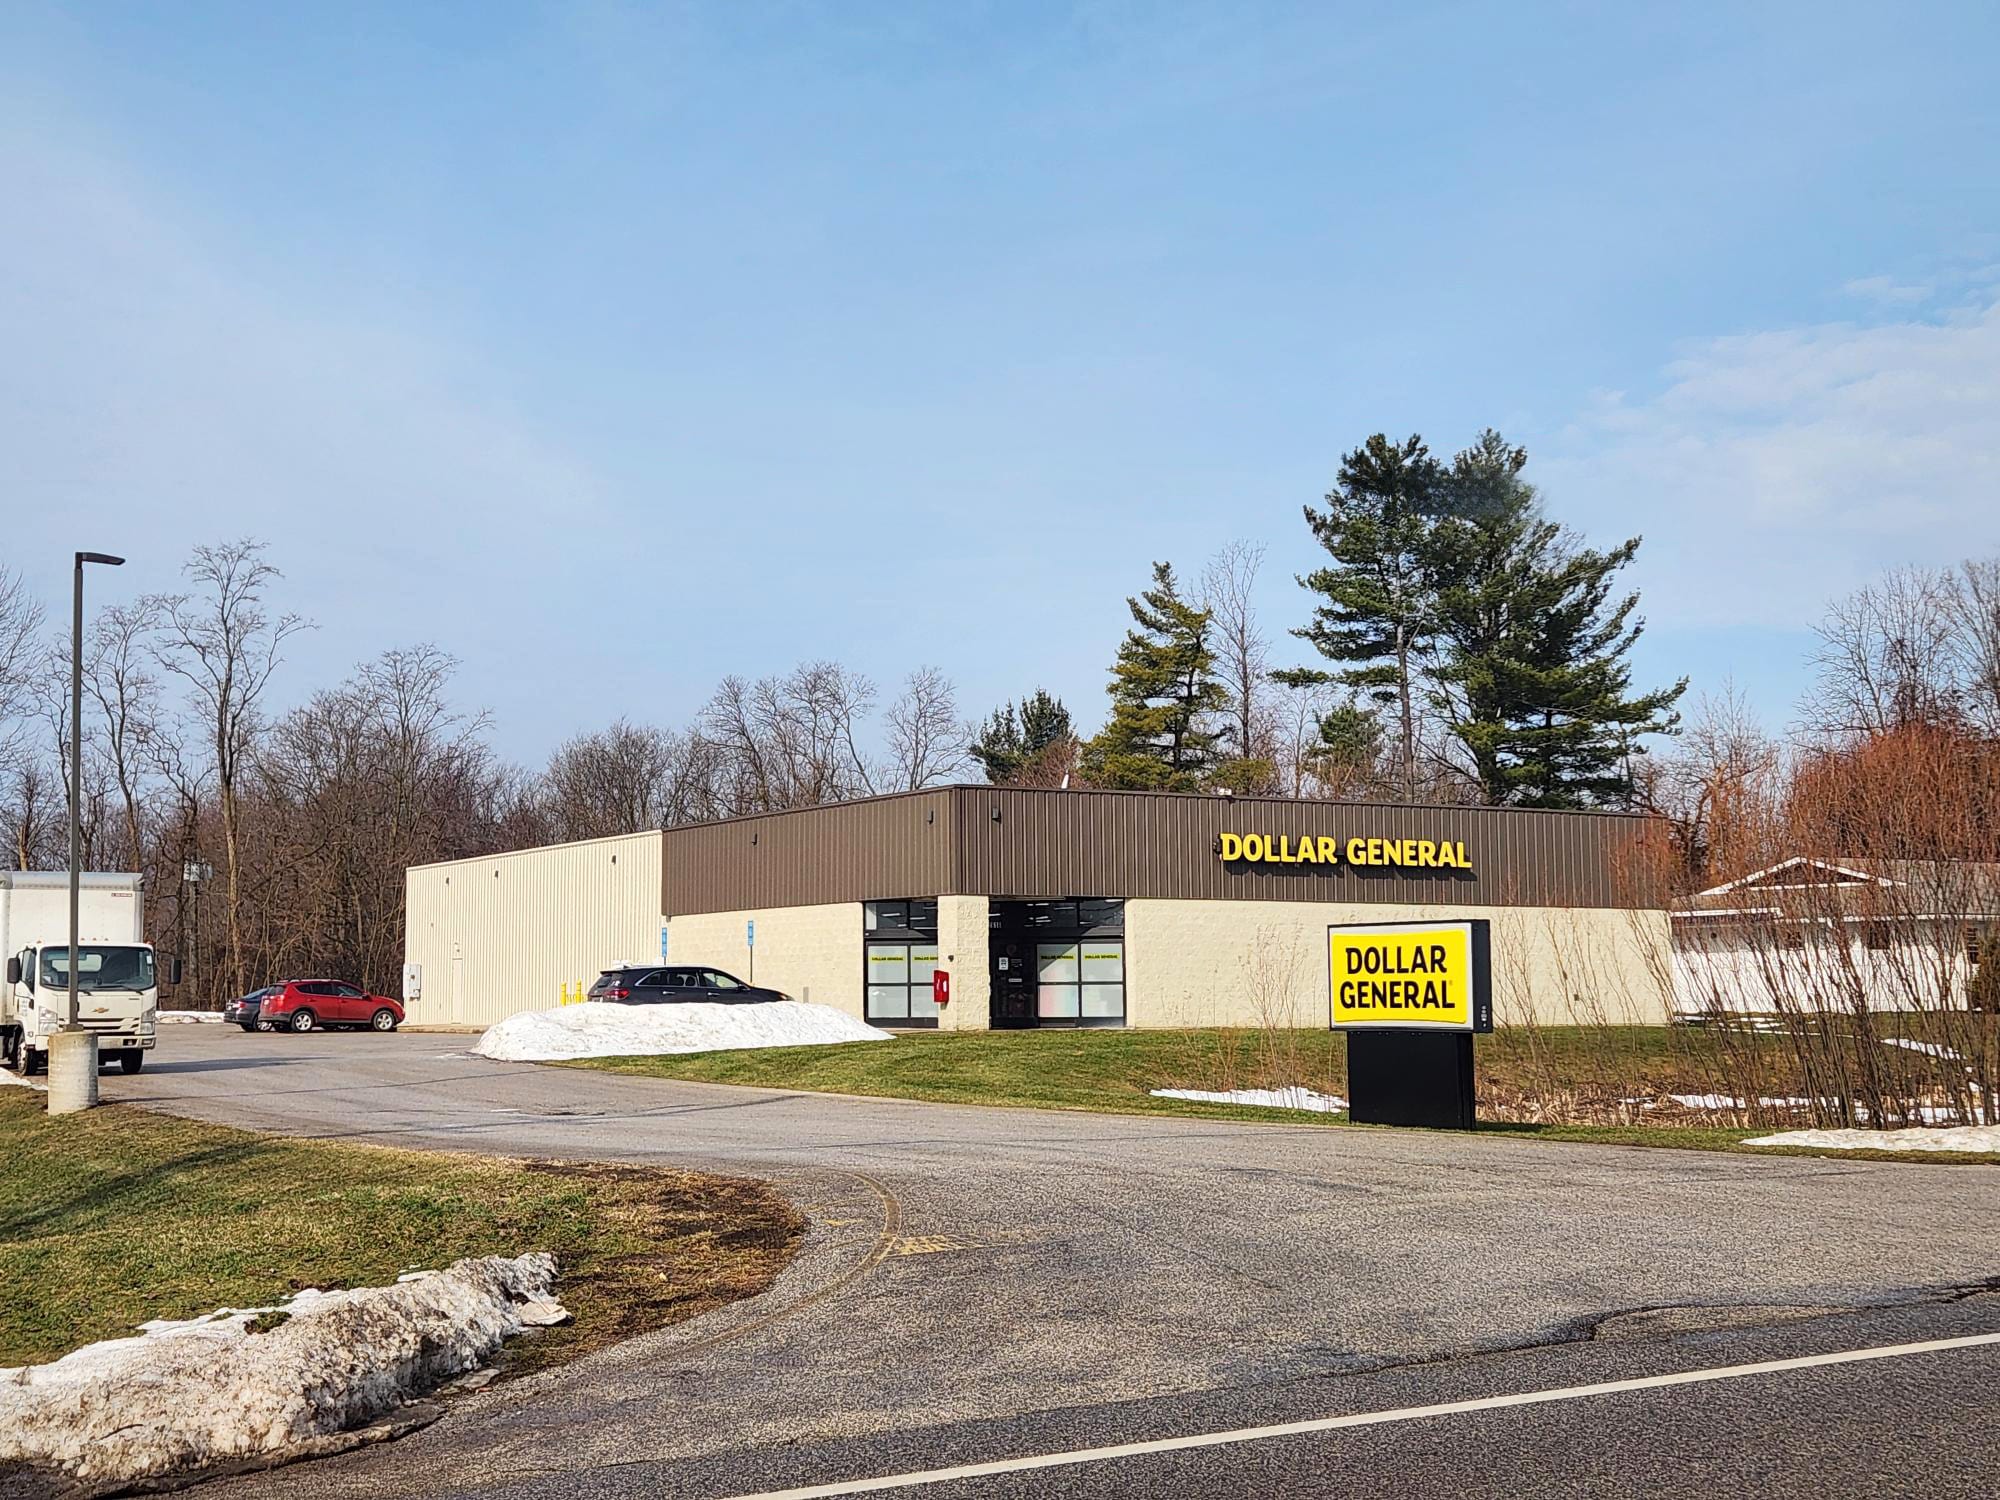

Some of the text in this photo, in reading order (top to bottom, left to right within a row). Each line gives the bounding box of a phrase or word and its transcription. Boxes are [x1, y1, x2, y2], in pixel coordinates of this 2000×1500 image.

[1220, 833, 1473, 868] DOLLAR GENERAL
[1345, 945, 1447, 974] DOLLAR
[1340, 980, 1455, 1009] GENERAL
